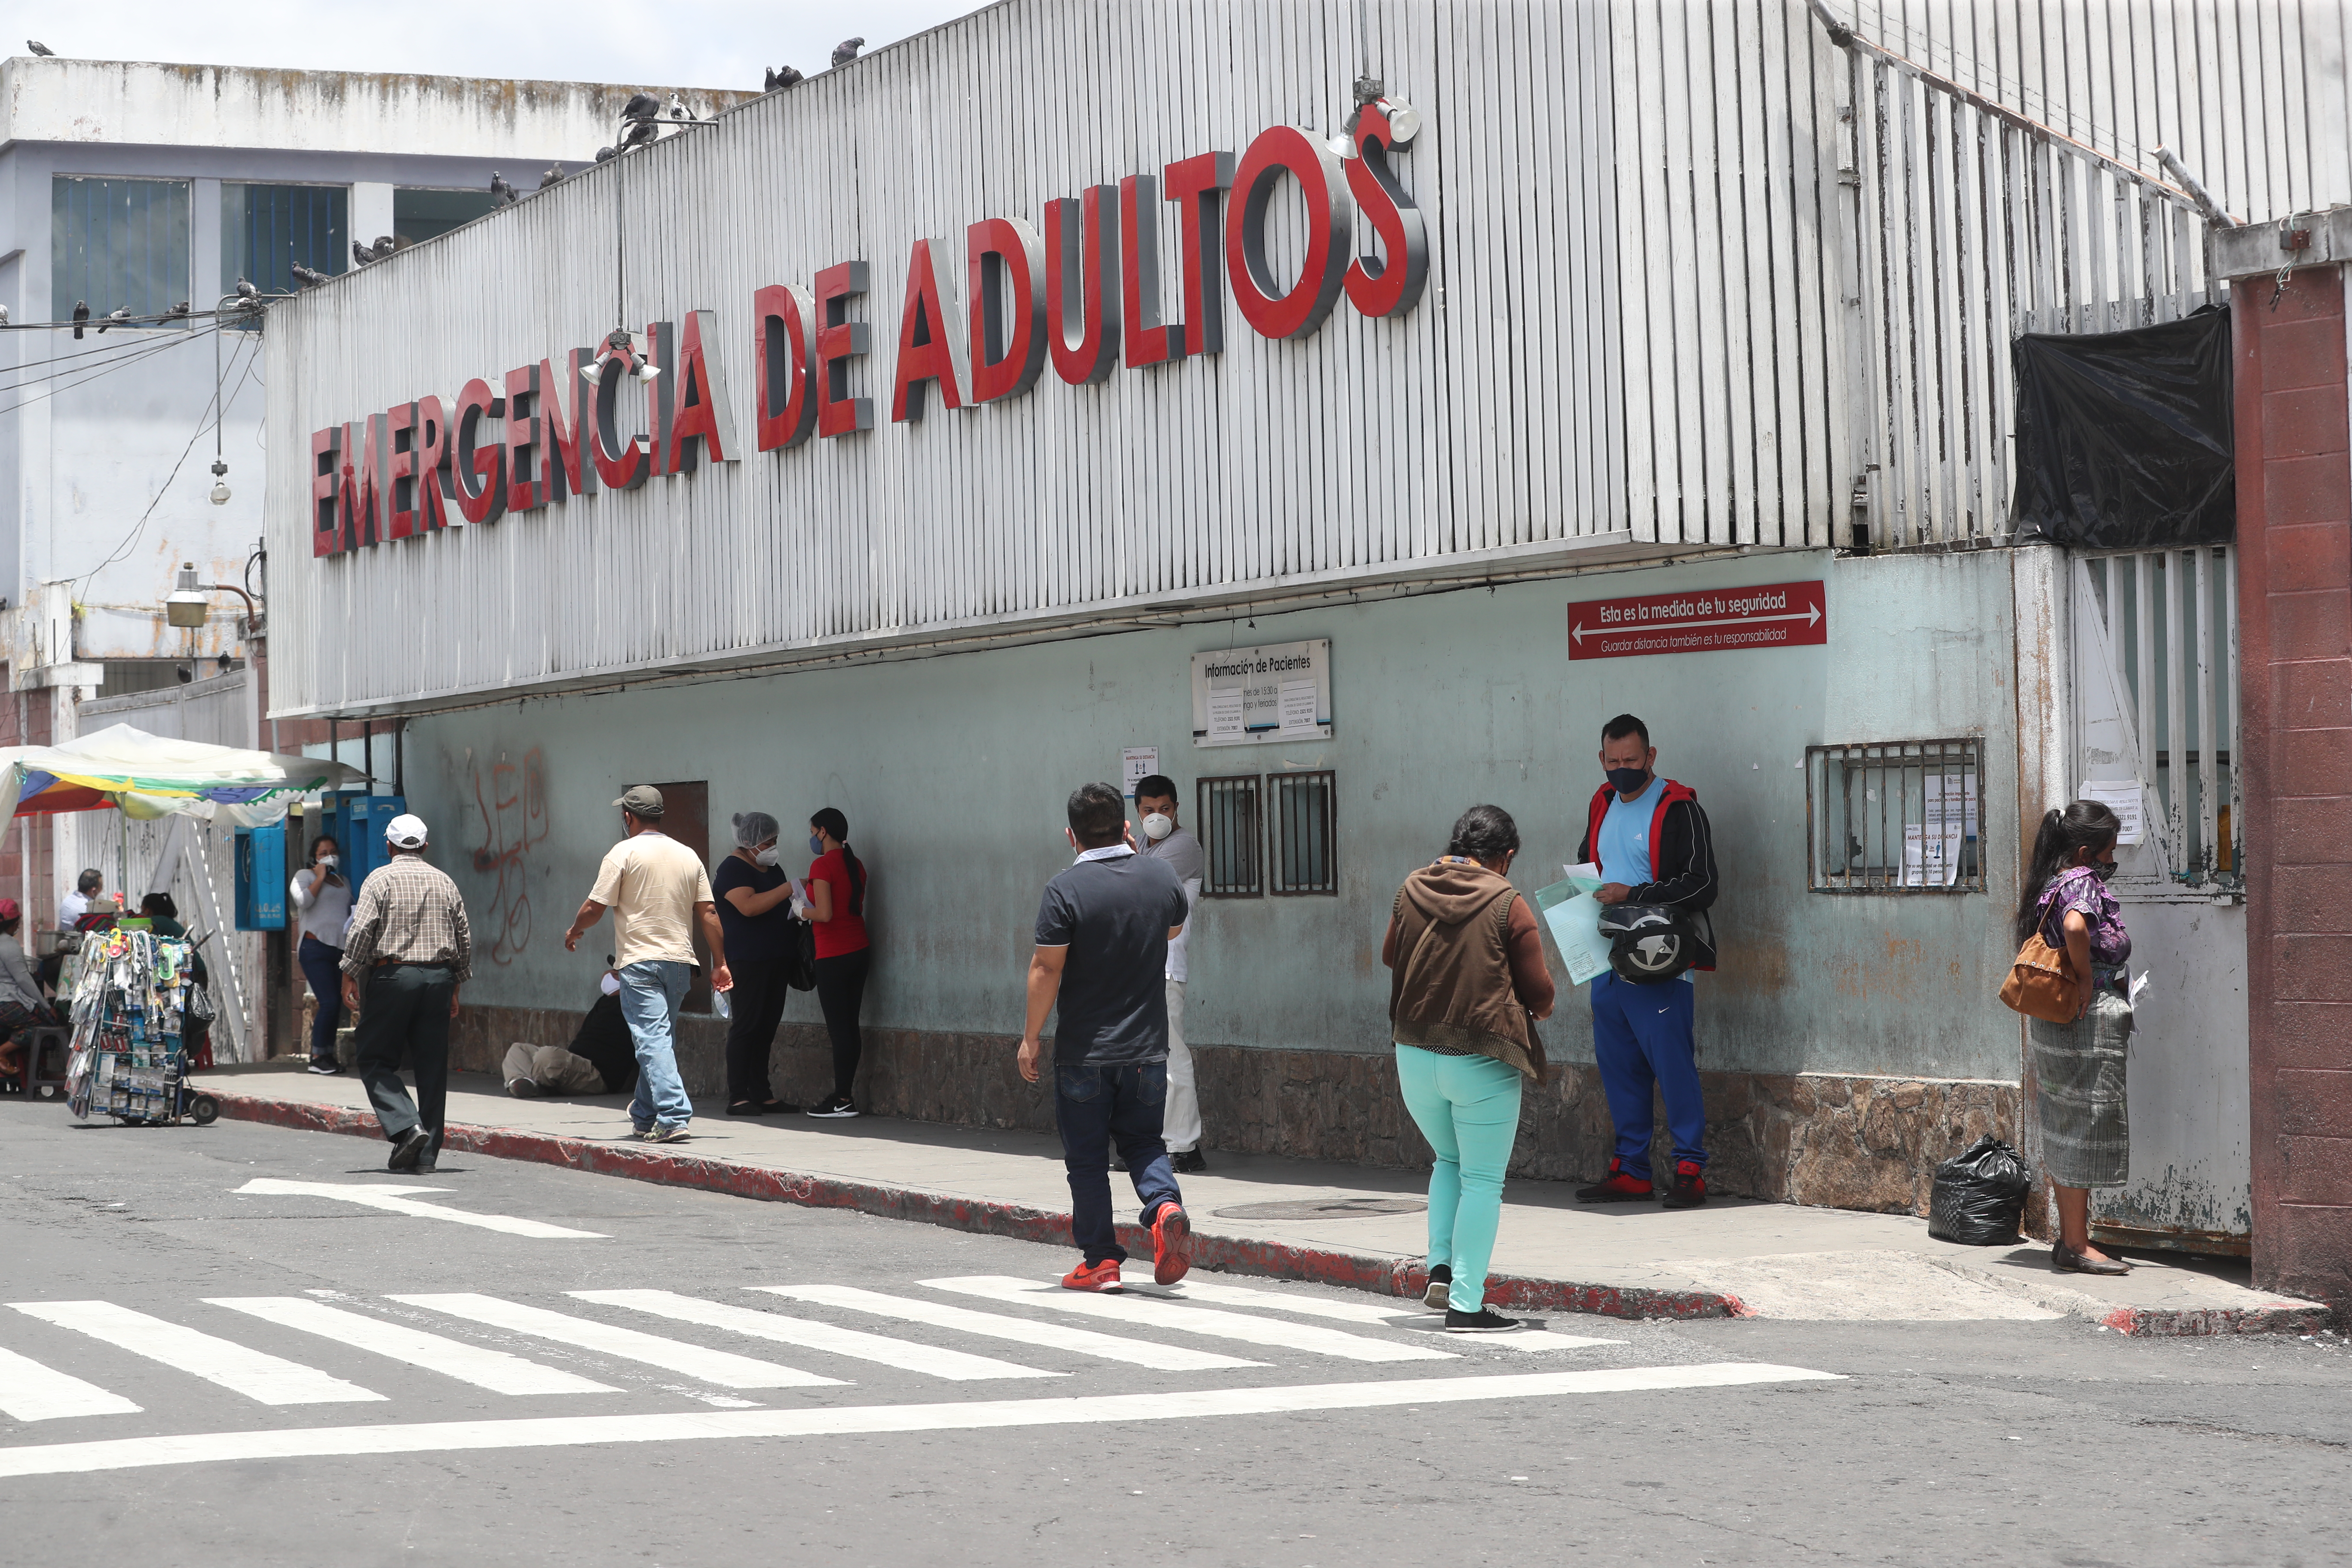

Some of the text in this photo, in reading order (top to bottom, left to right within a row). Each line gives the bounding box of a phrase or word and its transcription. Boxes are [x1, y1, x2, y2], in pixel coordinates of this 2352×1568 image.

[312, 96, 1429, 558] EMERGENCIA DE ADULTOS
[1600, 591, 1786, 623] Esta es la medida de tu seguridad
[1601, 627, 1786, 652] Guardar distancia también es tu responsabilidad
[1205, 654, 1311, 678] Información de Pacientes
[1253, 687, 1260, 696] de
[1261, 686, 1273, 695] 15:30
[1254, 701, 1257, 710] y
[1258, 698, 1277, 707] feriados
